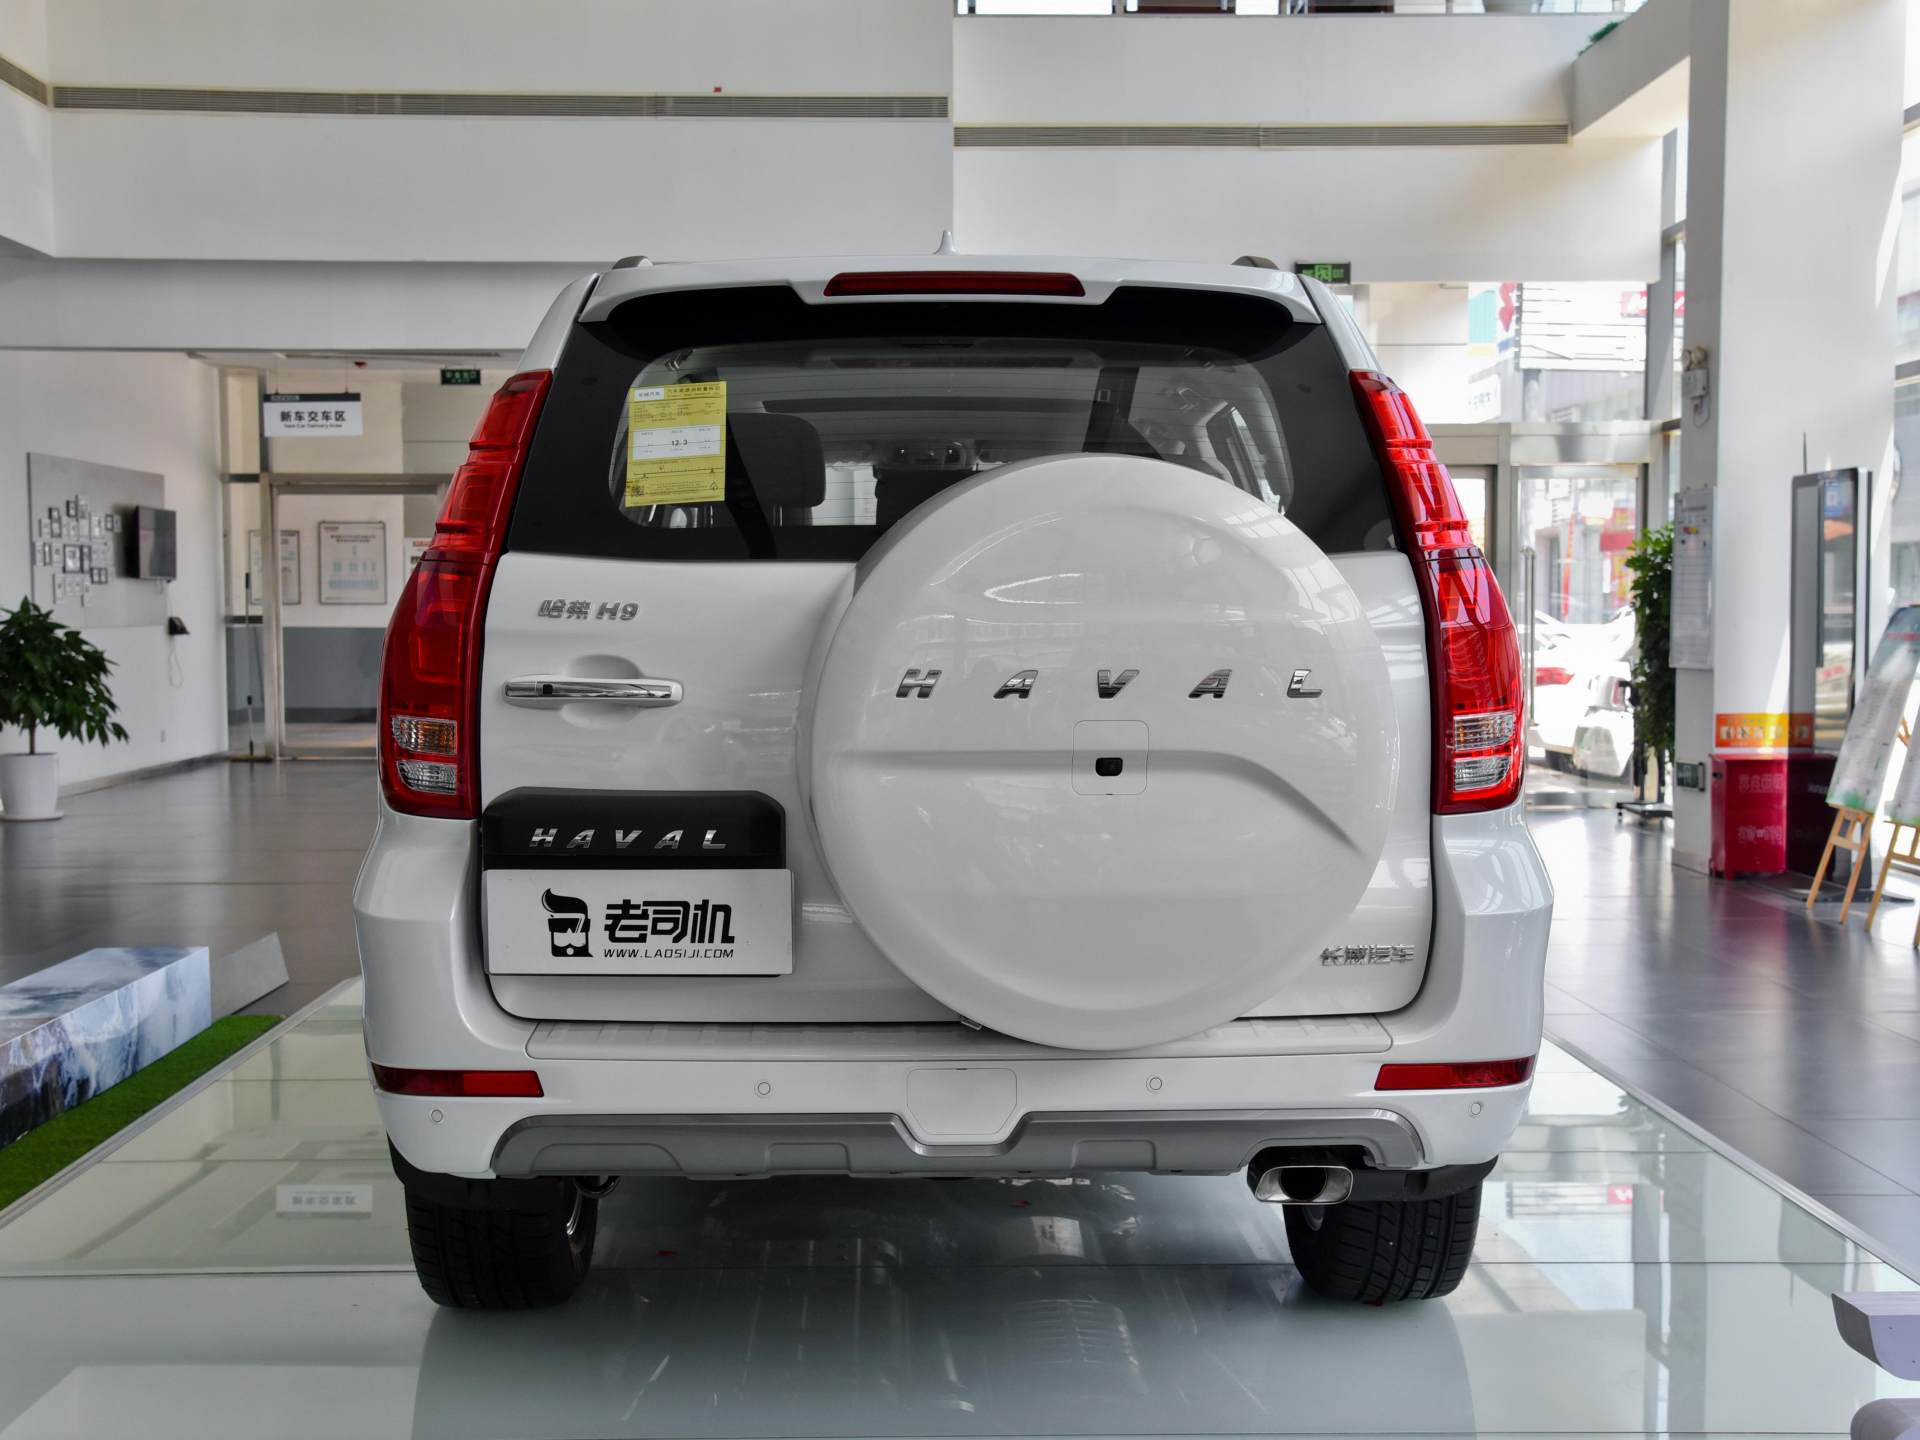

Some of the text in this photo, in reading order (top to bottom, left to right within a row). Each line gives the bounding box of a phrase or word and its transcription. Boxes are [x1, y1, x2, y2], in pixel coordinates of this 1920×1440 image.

[280, 410, 346, 422] 新车交车区
[596, 602, 639, 620] H9
[896, 669, 1323, 699] HAVAL
[529, 828, 727, 849] HAVAL
[604, 899, 735, 944] 老司机
[603, 948, 735, 959] WWW.LAOSIJI.COM
